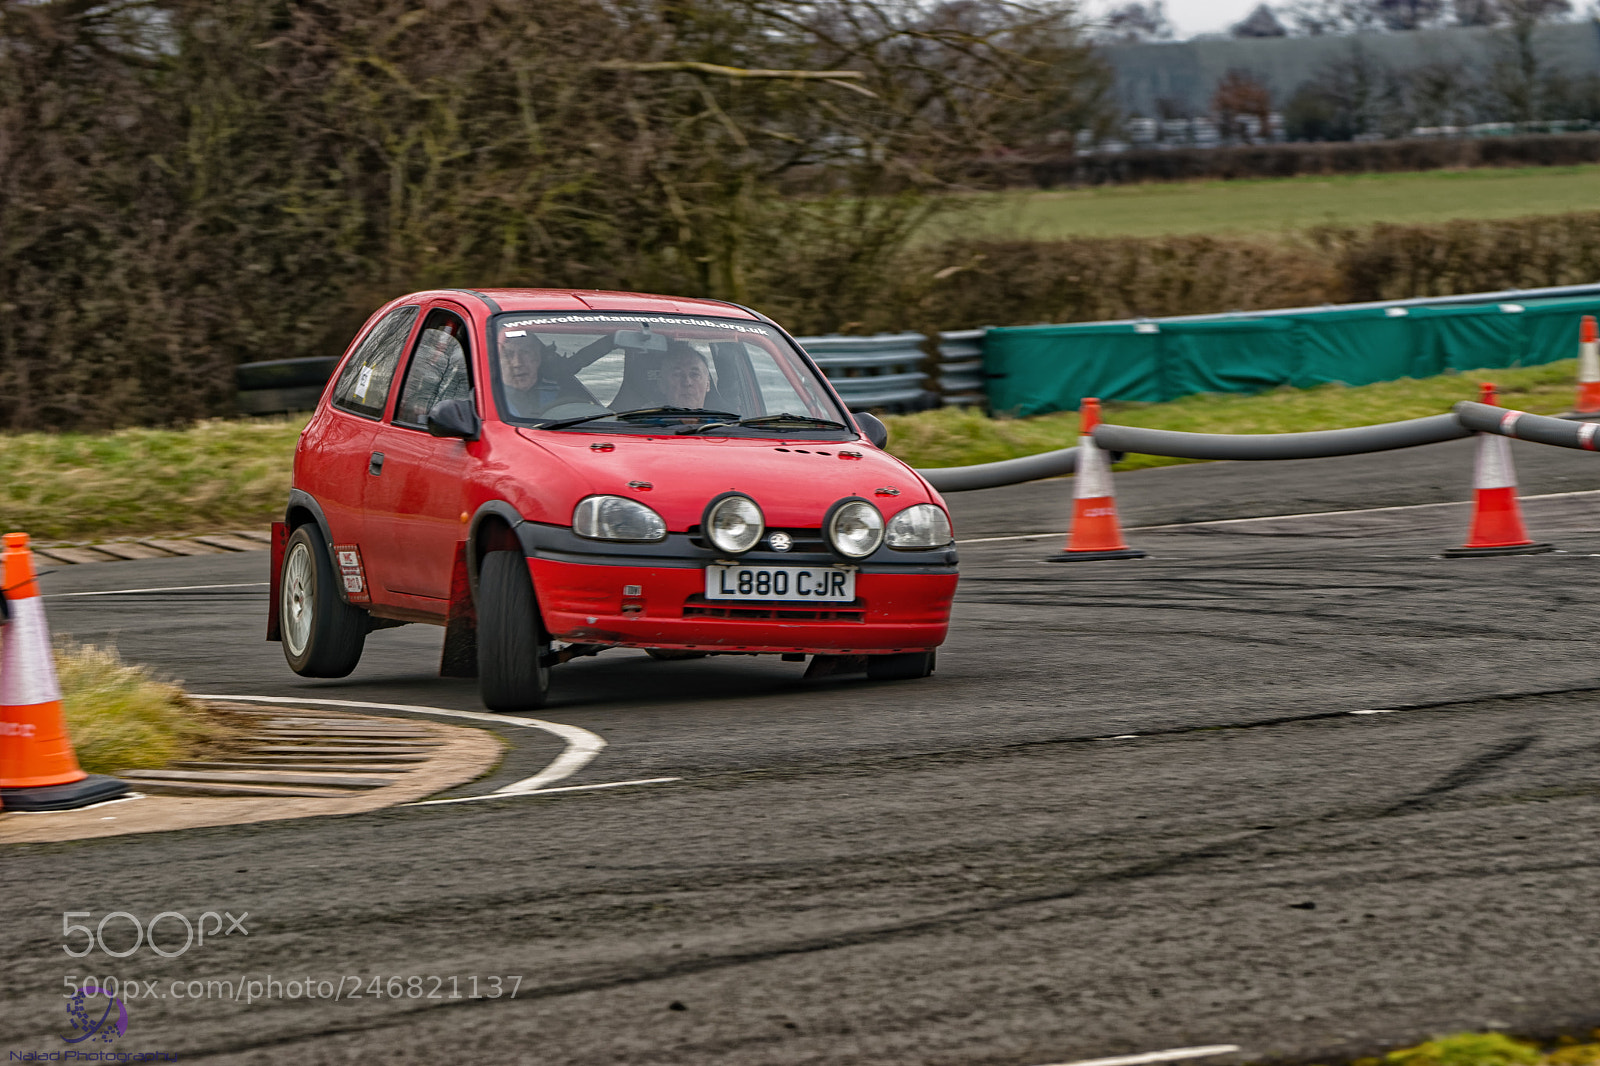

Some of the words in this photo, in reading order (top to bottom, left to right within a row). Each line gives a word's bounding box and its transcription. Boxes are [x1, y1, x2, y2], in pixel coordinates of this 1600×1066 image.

[503, 315, 769, 336] www.rotherhammotorclub.org.uk
[719, 569, 789, 596] L880
[796, 571, 847, 597] CJR
